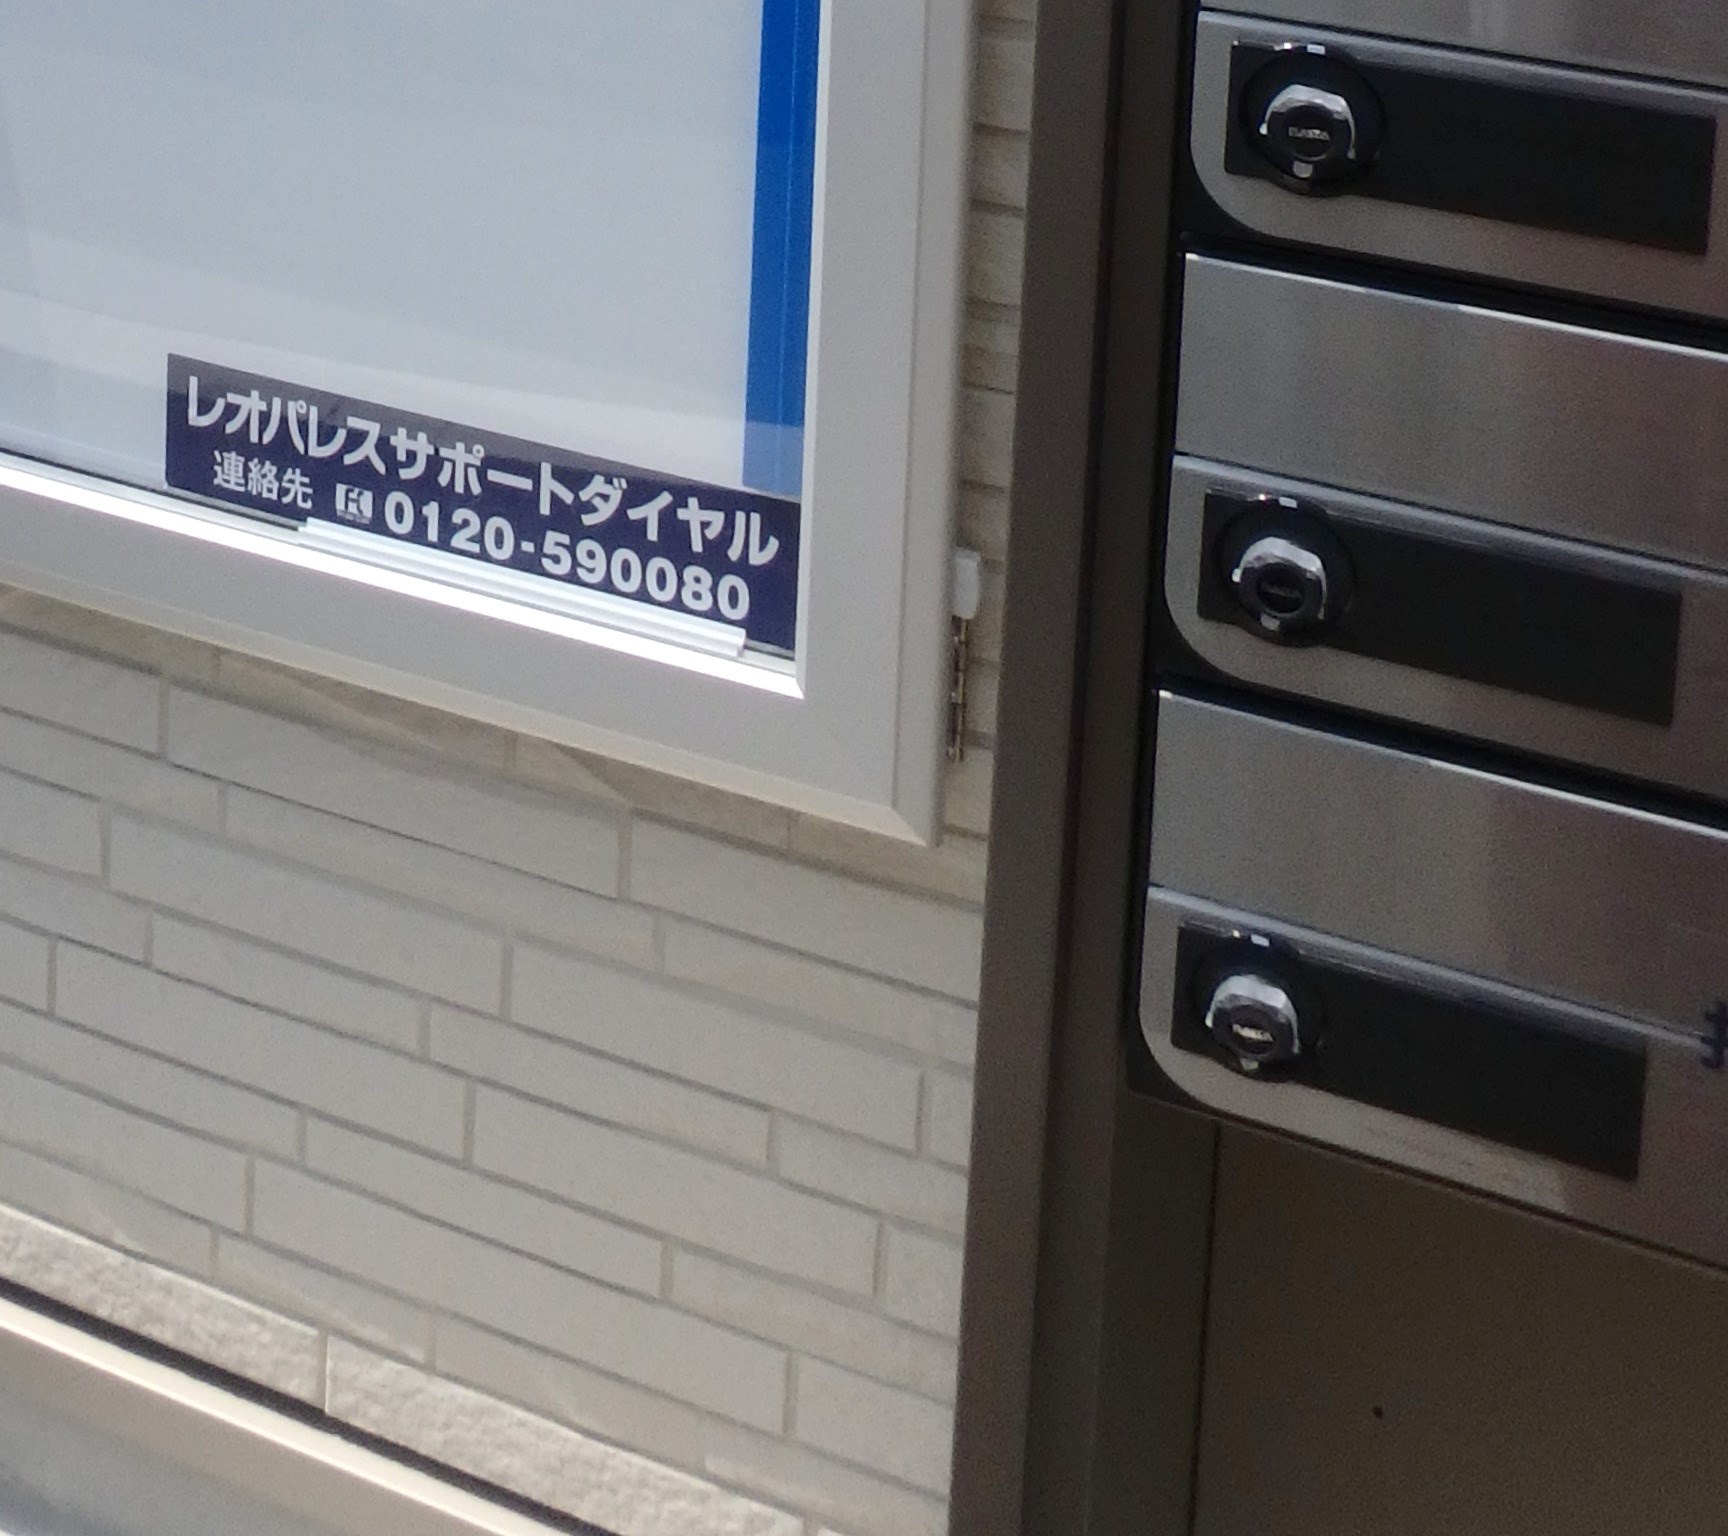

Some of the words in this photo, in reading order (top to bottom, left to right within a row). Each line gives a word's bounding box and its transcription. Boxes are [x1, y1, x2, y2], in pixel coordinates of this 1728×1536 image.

[185, 374, 780, 568] レオパレスサポートダイヤル
[213, 450, 313, 510] 連絡先
[384, 491, 752, 622] 0120-590080
